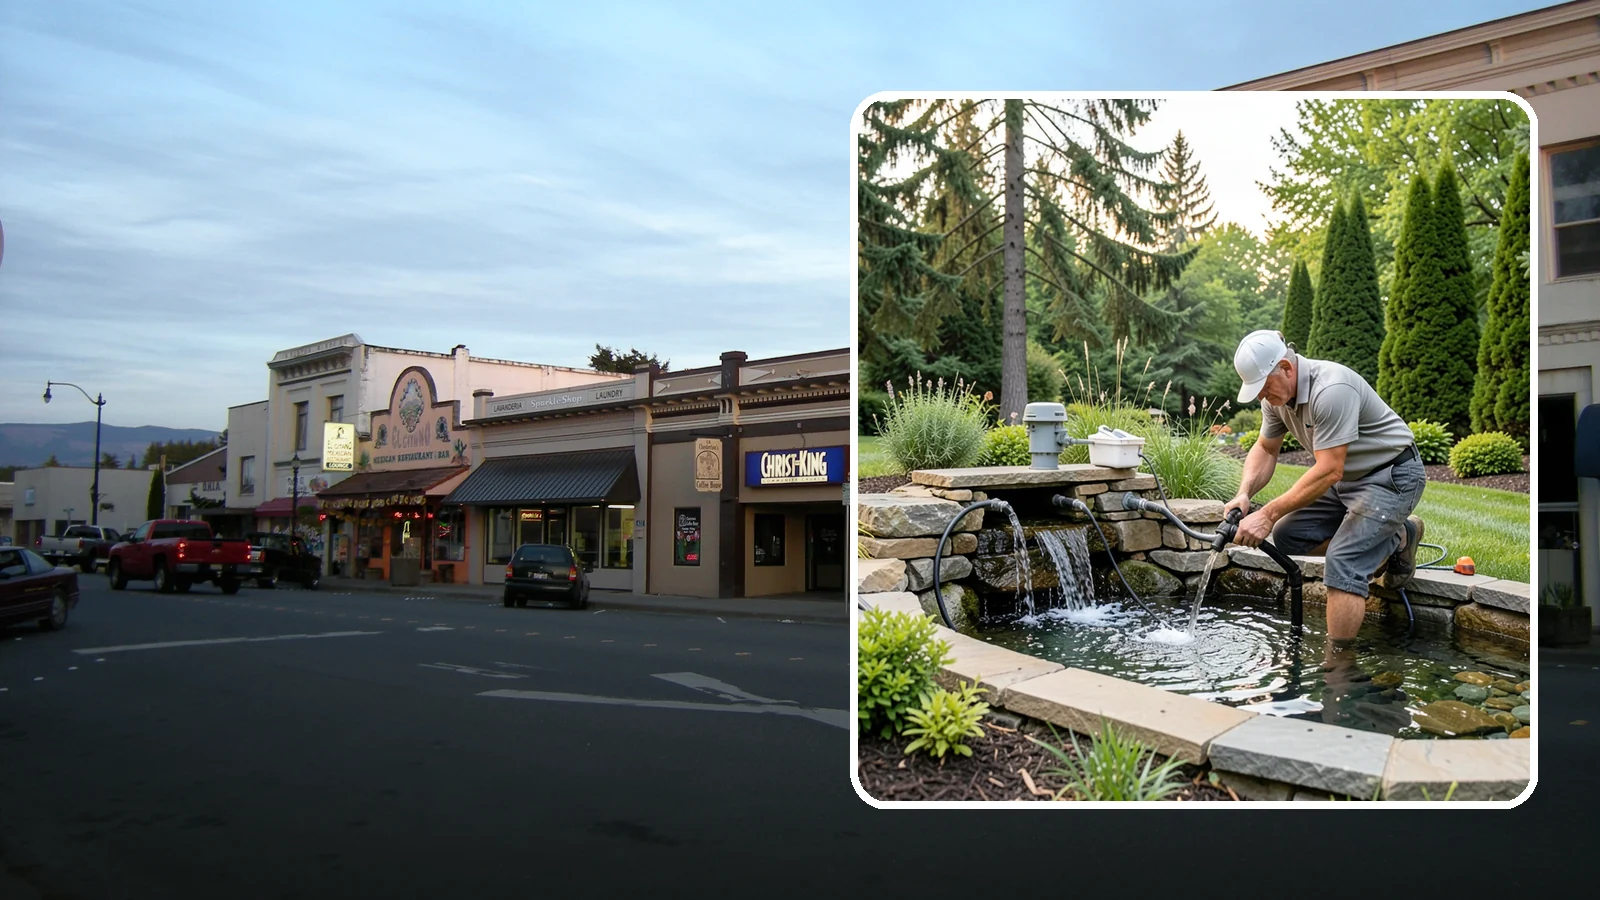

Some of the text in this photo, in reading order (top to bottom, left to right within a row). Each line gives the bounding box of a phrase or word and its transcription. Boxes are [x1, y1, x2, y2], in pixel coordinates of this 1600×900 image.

[562, 394, 582, 405] Shop
[596, 389, 623, 400] LAUNDRY
[494, 402, 522, 412] LAVANDERIA
[373, 450, 450, 464] MEXICAN RESTAURANT BAR
[761, 450, 827, 478] CHRIST KING
